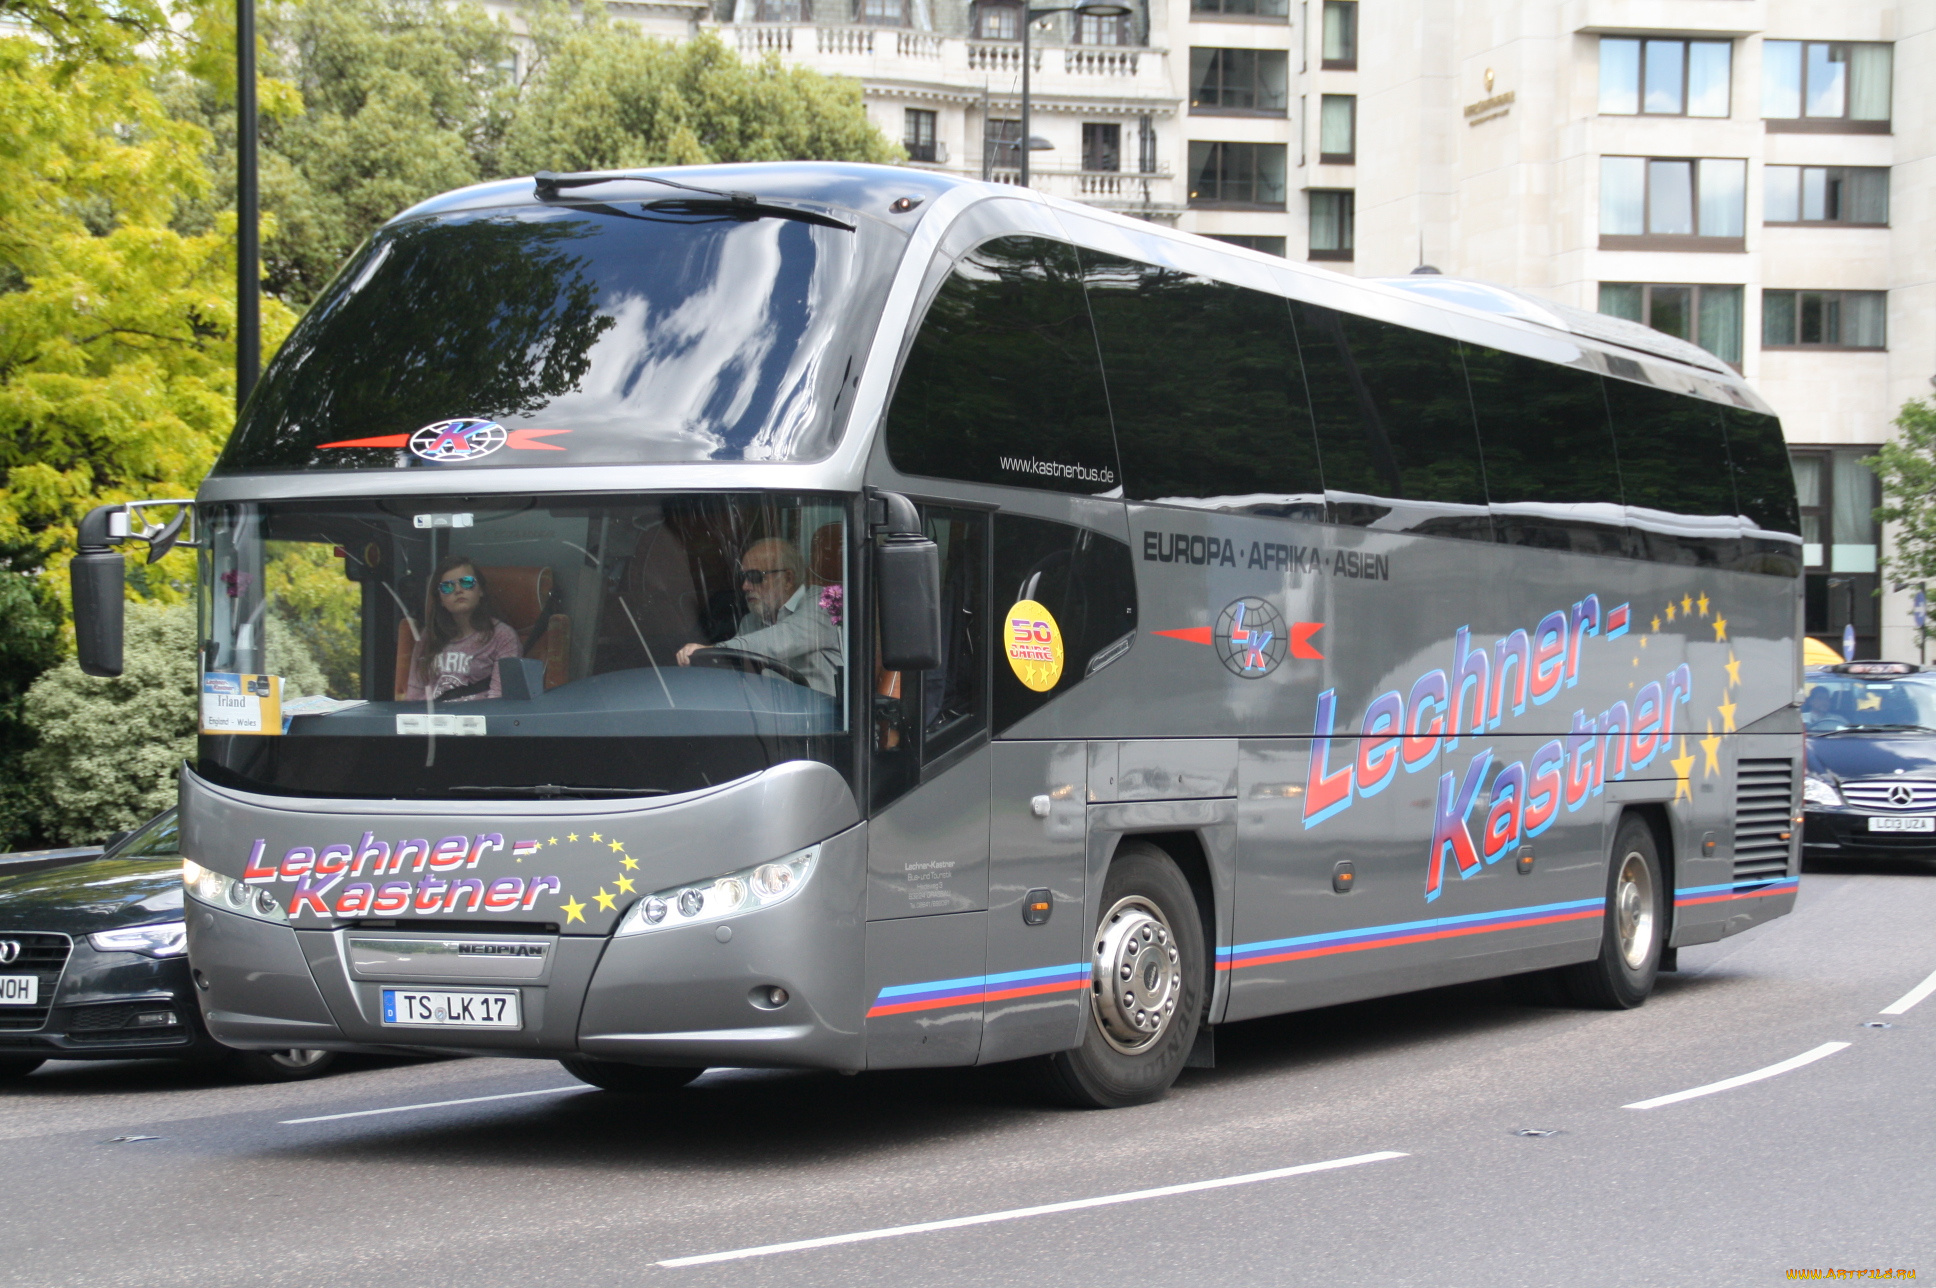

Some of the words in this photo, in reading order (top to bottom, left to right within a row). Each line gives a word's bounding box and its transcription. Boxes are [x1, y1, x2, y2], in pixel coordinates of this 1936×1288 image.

[999, 456, 1114, 483] www.kastnerbus.de
[1143, 531, 1236, 567] EUROPA
[1247, 541, 1322, 575] AFRIKA
[1333, 550, 1389, 581] ASIEN
[1011, 619, 1052, 644] 50
[1009, 643, 1054, 662] JAHRE
[218, 695, 246, 708] Irland
[1302, 593, 1631, 830] Lechner-
[208, 716, 230, 727] England
[237, 718, 257, 727] Wales
[1425, 662, 1692, 903] Kastner
[243, 830, 538, 884] Lechner-
[288, 873, 561, 919] Kastner
[458, 943, 543, 957] NEOPLAN
[387, 1009, 394, 1017] D
[404, 995, 432, 1020] TS
[447, 996, 475, 1021] LK
[480, 997, 507, 1022] 17
